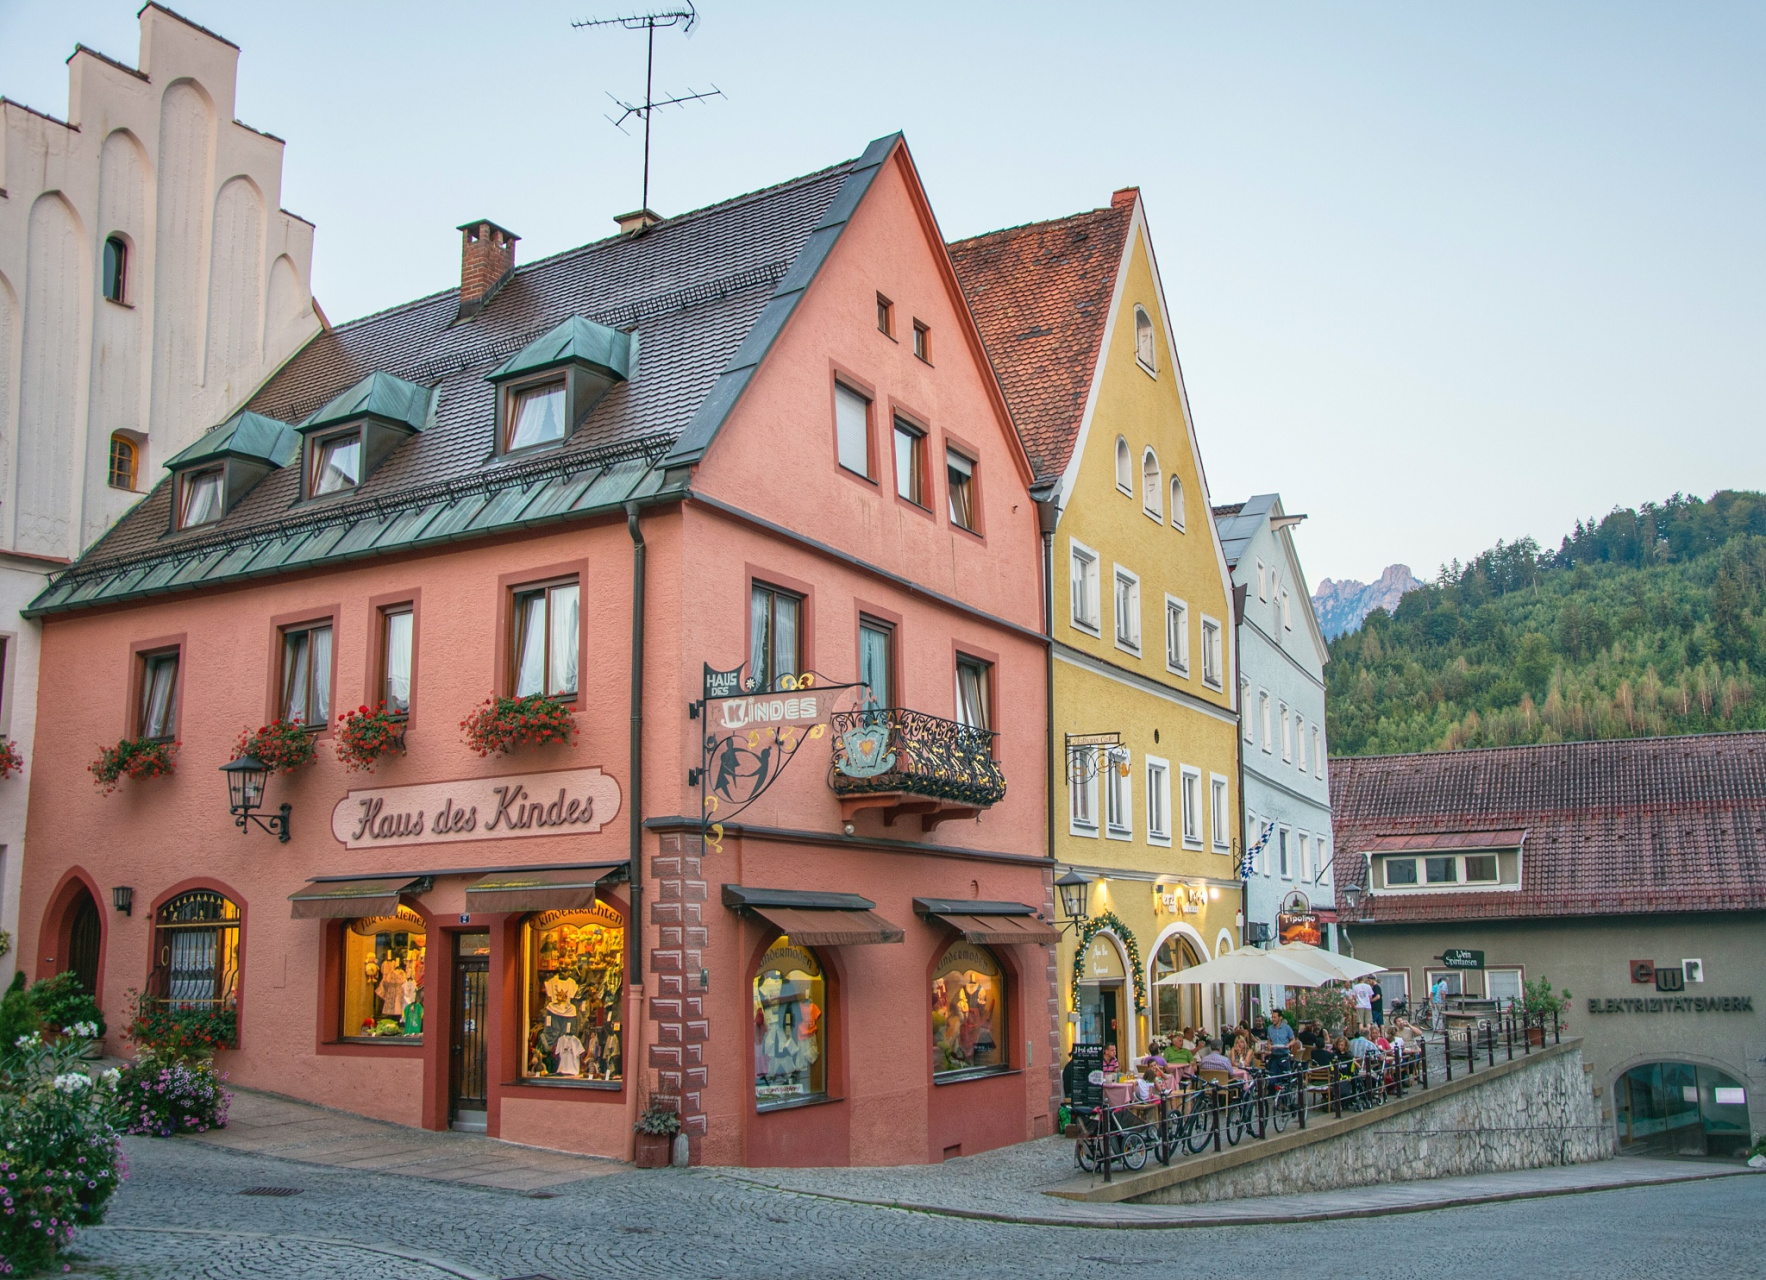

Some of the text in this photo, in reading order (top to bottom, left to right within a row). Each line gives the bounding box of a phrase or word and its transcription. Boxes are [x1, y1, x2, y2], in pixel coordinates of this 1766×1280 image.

[706, 673, 738, 688] HAUS
[711, 687, 729, 696] DES
[352, 785, 593, 840] Haus des Kindes
[1456, 950, 1472, 959] Wein
[1632, 961, 1700, 990] ewr
[1588, 996, 1753, 1013] ELEKTRIZITÄTSWERK
